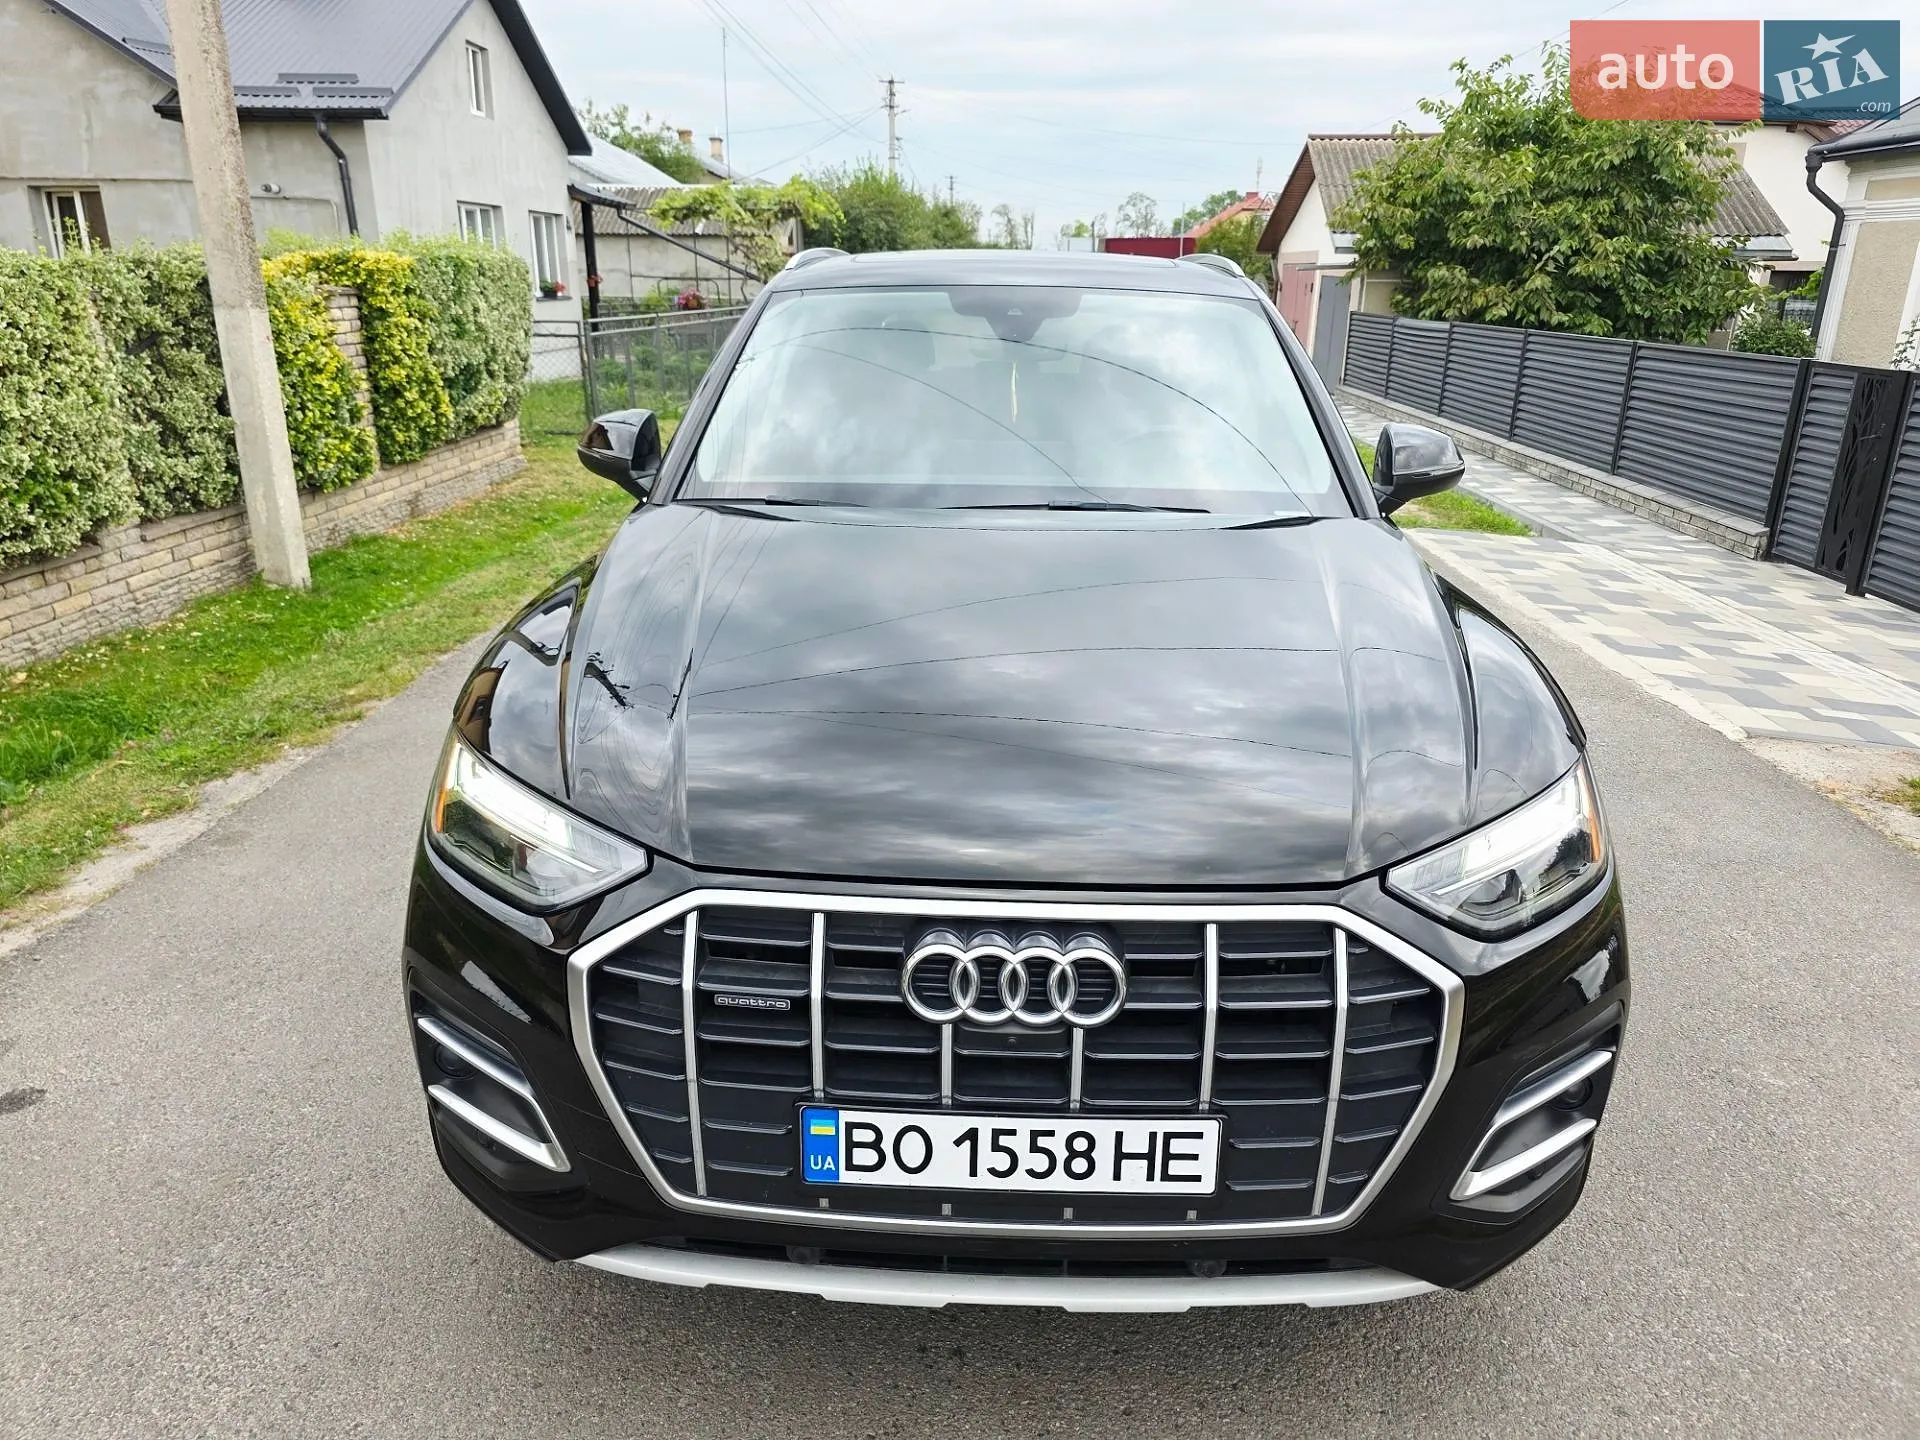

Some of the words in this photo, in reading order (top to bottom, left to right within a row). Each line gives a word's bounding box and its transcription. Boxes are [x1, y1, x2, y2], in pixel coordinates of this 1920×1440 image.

[717, 997, 787, 1008] quattro
[844, 1121, 933, 1175] BO
[952, 1127, 1097, 1181] 1558
[1112, 1131, 1204, 1182] HE
[810, 1155, 836, 1171] UA
